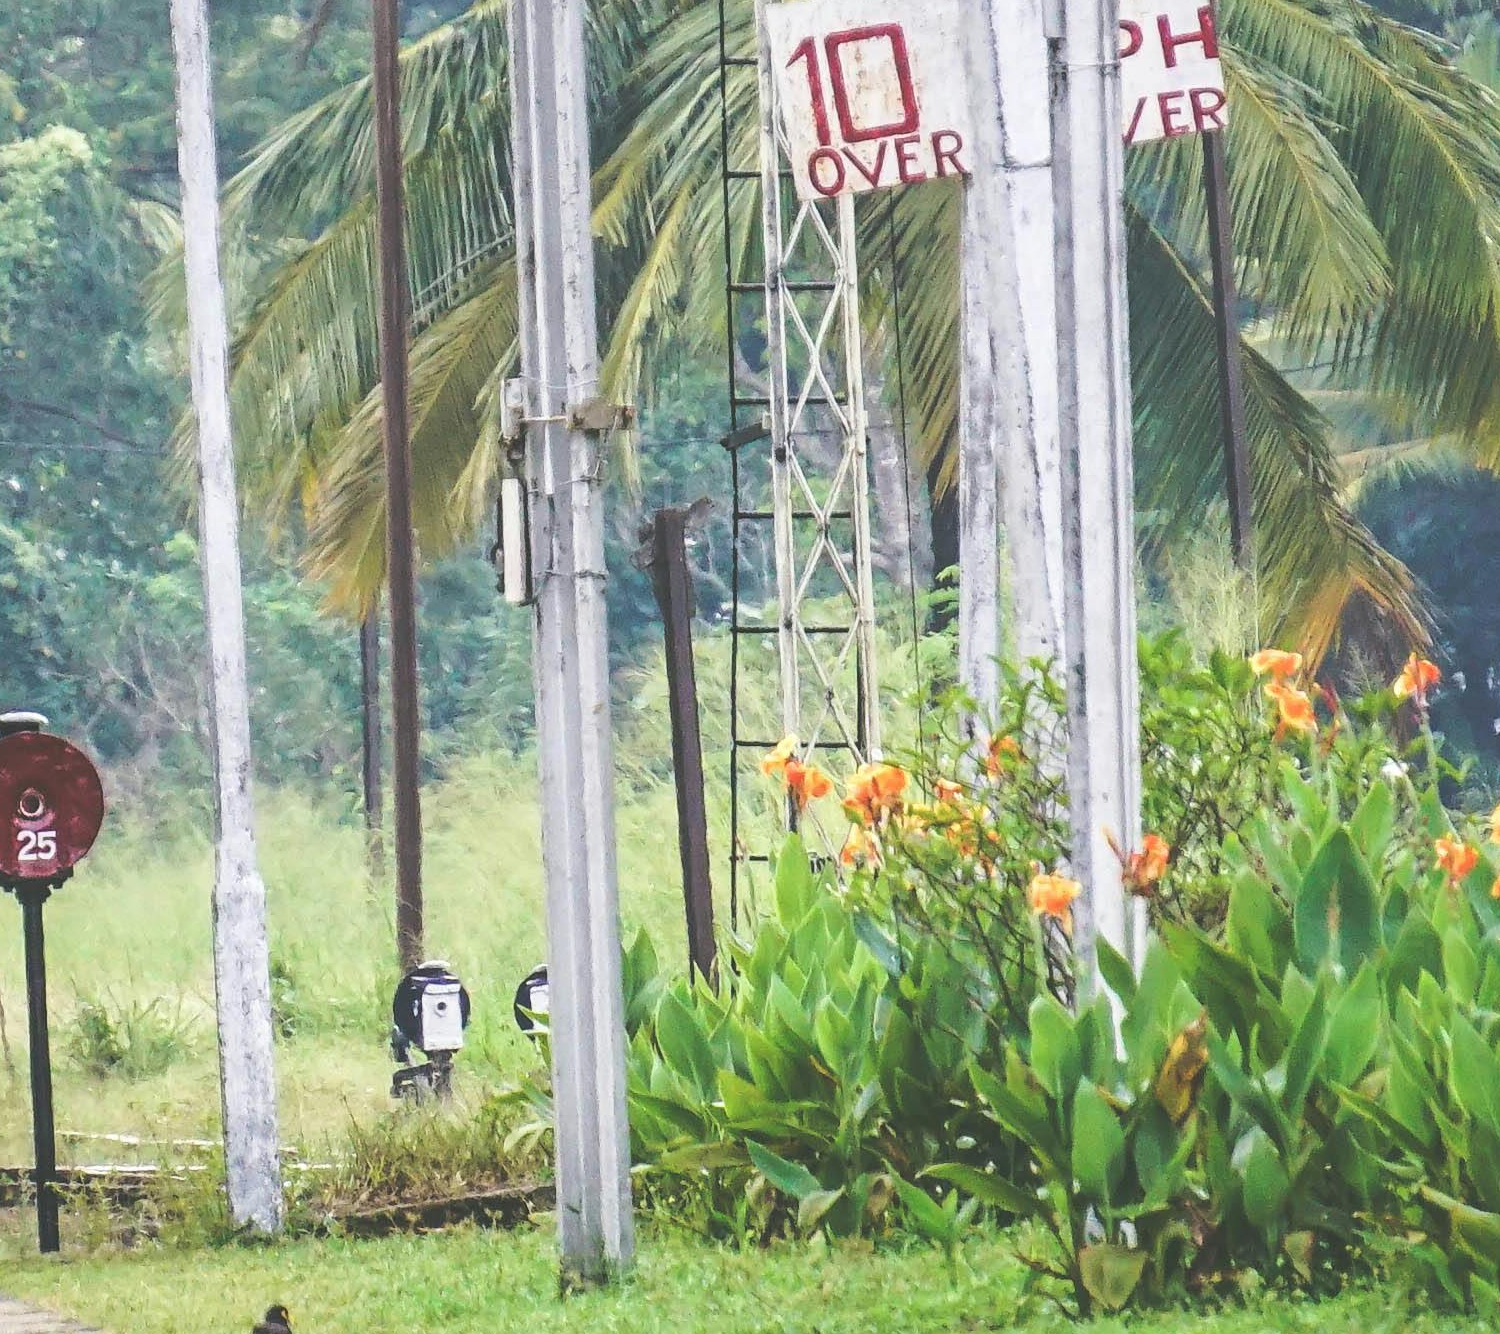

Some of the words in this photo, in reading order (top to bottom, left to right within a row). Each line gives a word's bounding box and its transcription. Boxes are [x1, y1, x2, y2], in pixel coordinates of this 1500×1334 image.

[785, 22, 920, 147] 10
[807, 129, 967, 197] OVER
[16, 830, 57, 861] 25
